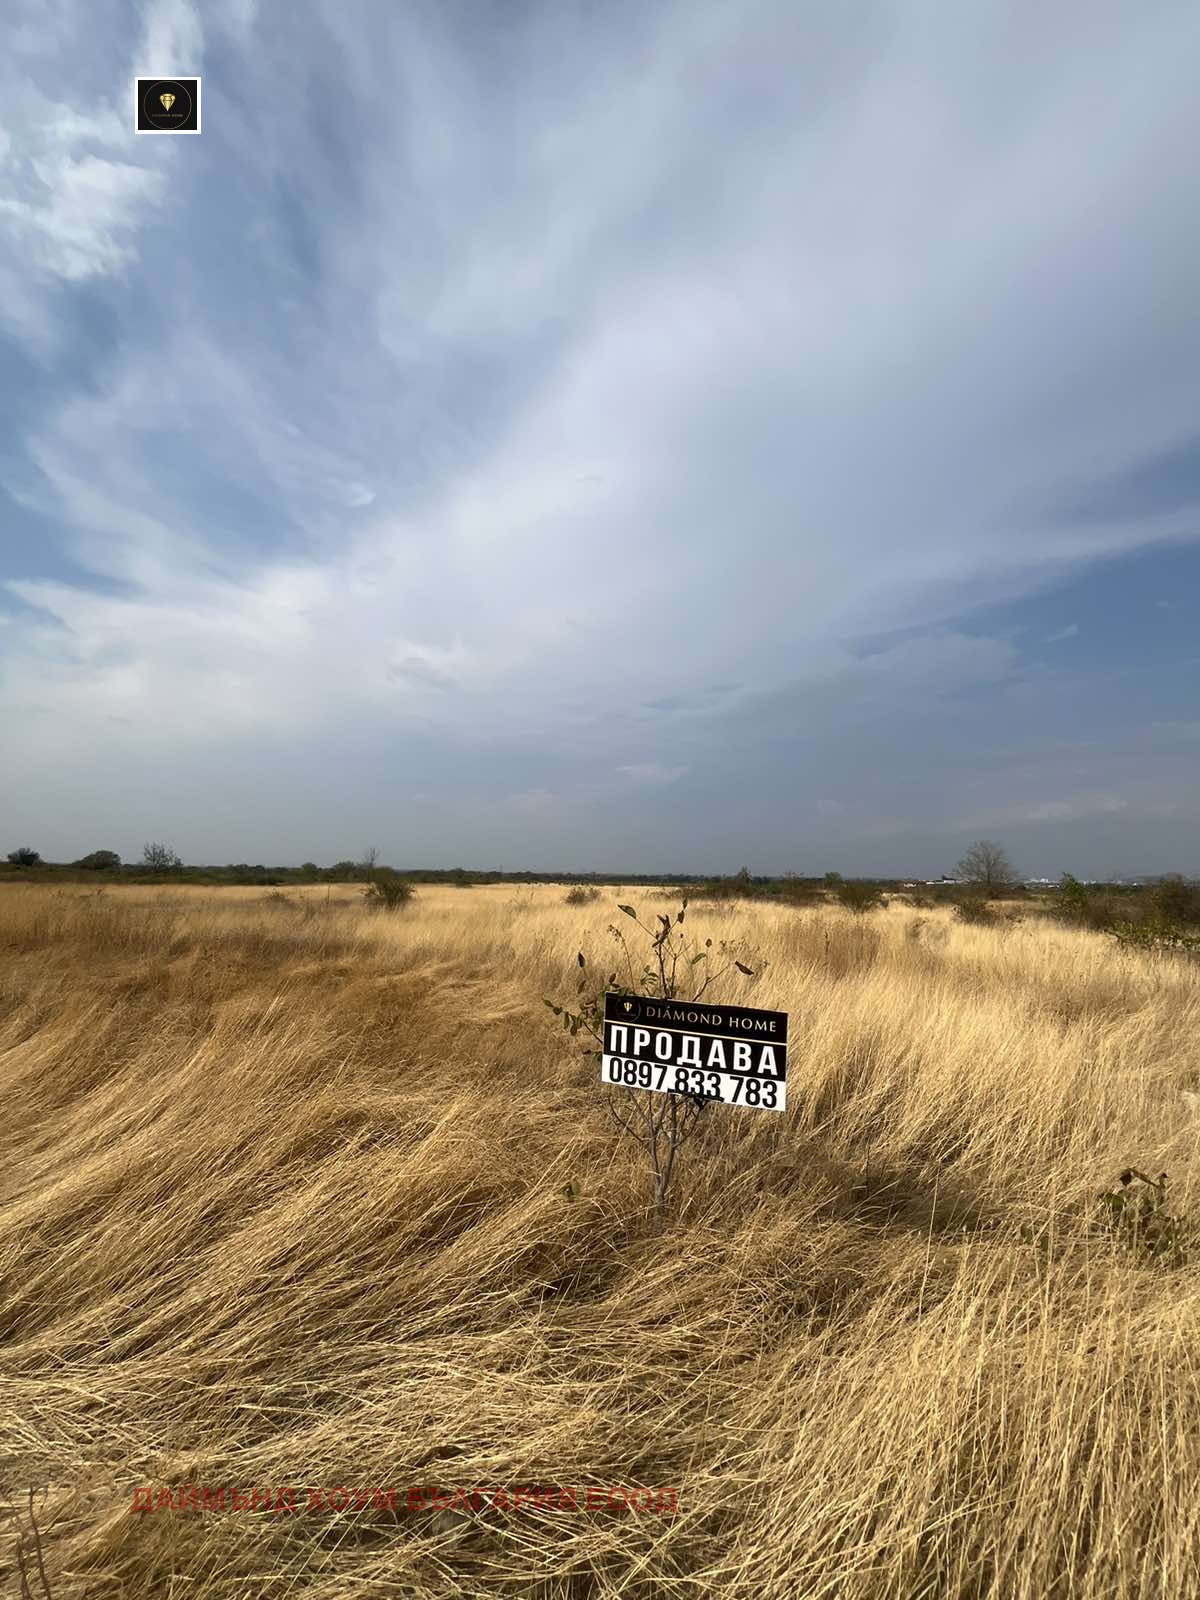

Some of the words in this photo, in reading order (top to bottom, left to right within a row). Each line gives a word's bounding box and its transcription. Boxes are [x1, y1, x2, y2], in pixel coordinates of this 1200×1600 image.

[646, 1006, 722, 1026] DIAMOND
[729, 1016, 777, 1033] HOME
[610, 1024, 778, 1076] ПРОДАВА
[609, 1056, 668, 1091] 0897
[674, 1068, 722, 1102] 833
[729, 1075, 778, 1109] 783
